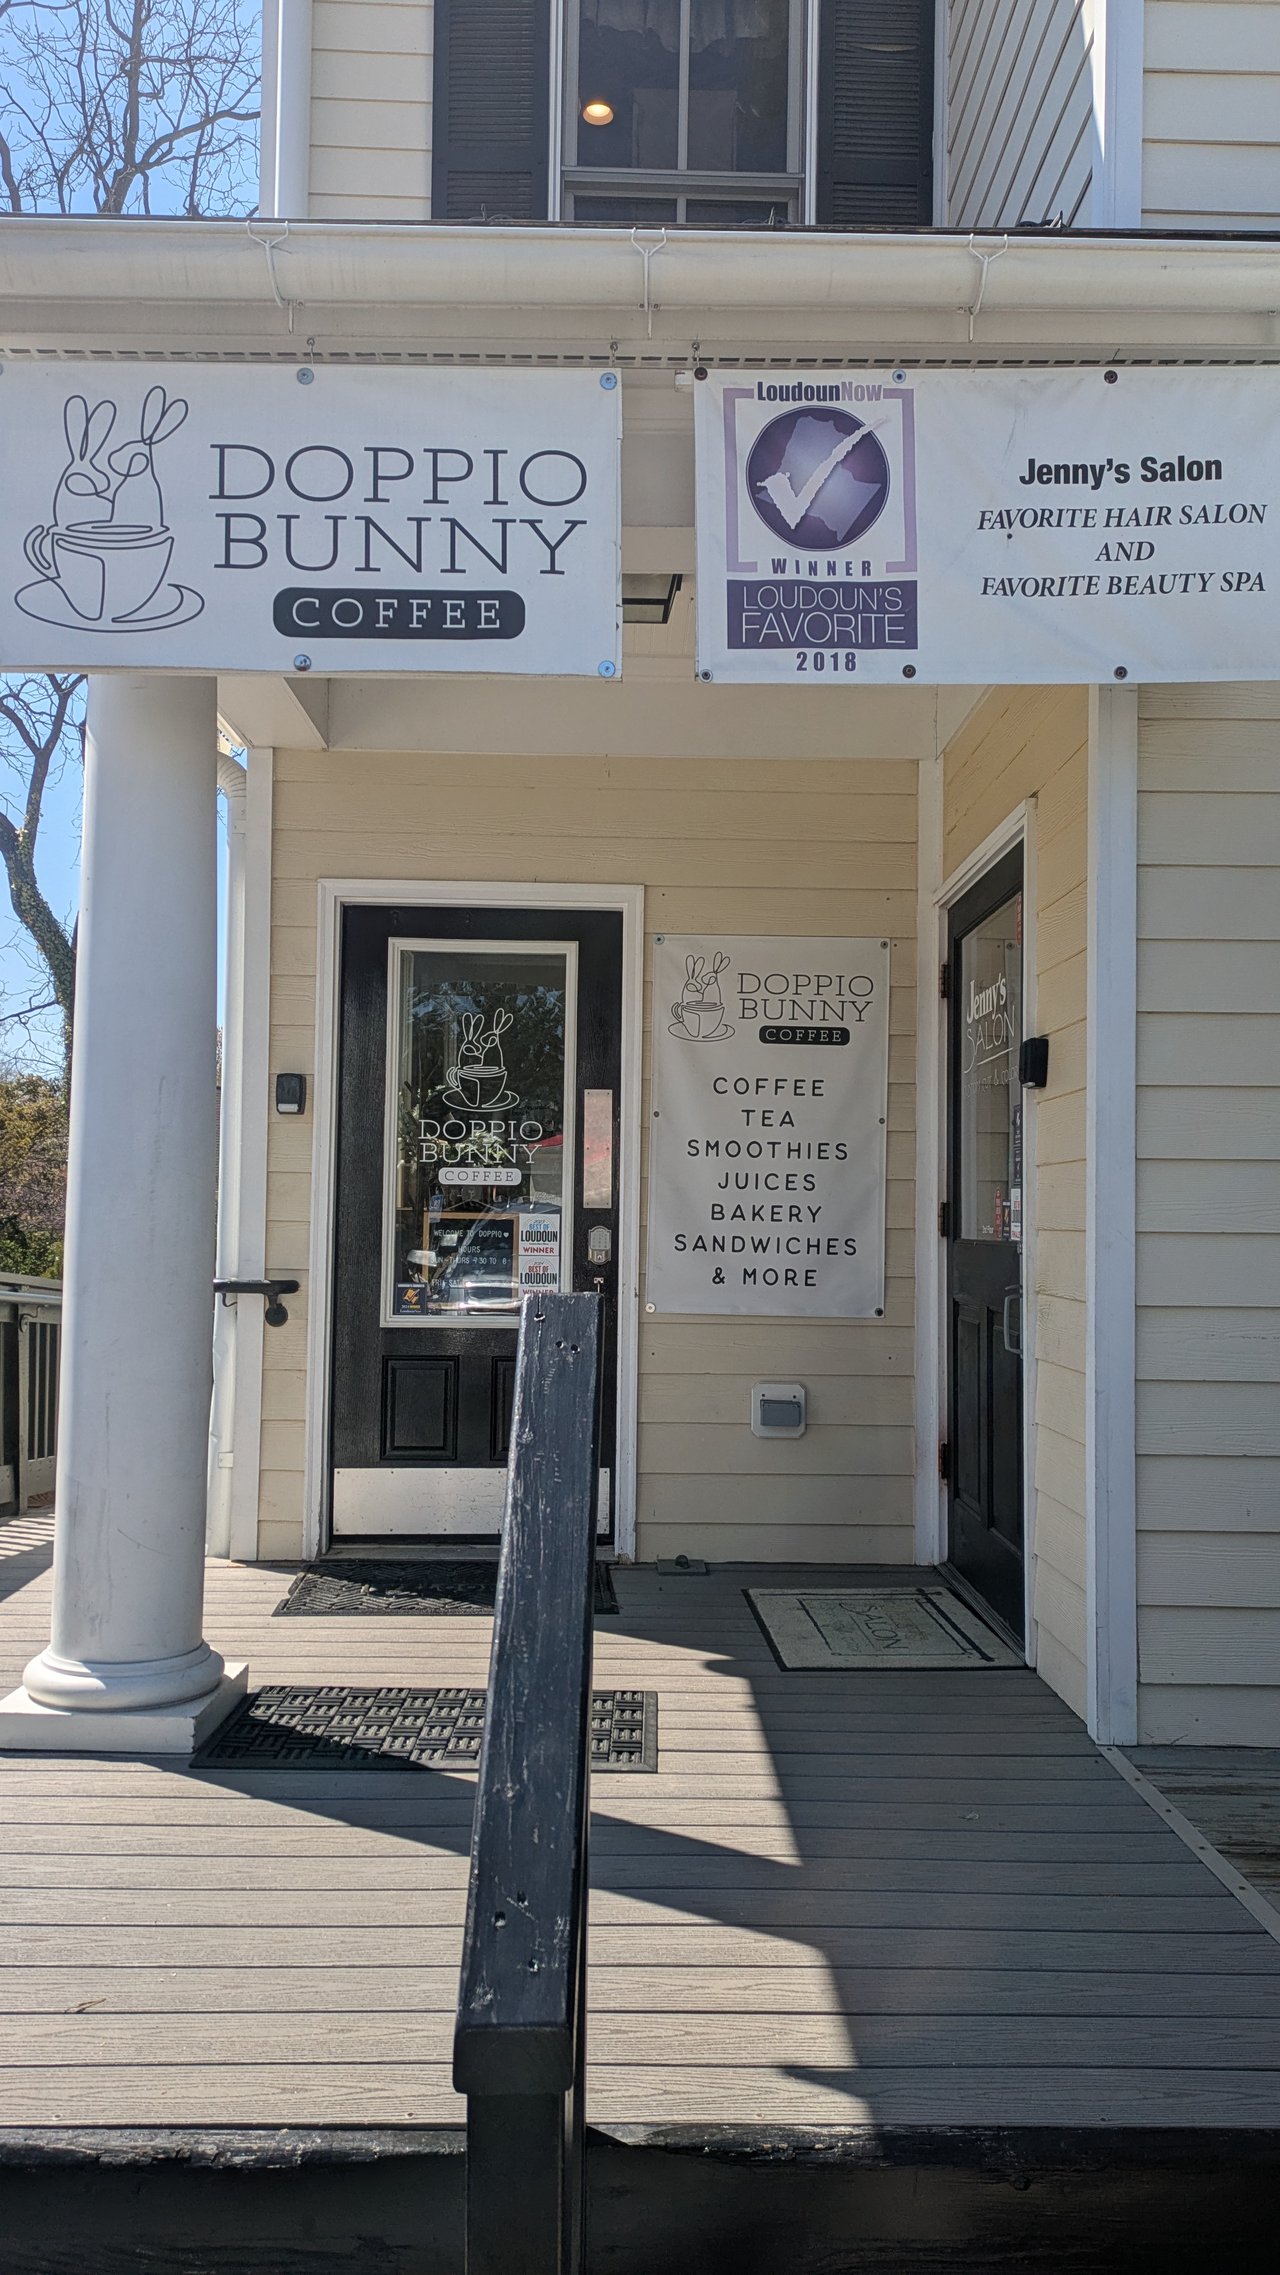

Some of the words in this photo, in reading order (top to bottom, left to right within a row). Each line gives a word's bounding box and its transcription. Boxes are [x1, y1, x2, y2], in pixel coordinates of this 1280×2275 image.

[757, 381, 882, 402] LoudounNow
[209, 444, 587, 506] DOPPIO
[1019, 458, 1131, 490] Jenny's
[1141, 455, 1222, 483] Salon
[977, 508, 1097, 531] FAVORITE
[1103, 506, 1172, 528] HAIR
[1179, 503, 1268, 526] SALON
[214, 513, 587, 575] BUNNY
[1095, 541, 1156, 562] AND
[771, 558, 872, 577] WINNER
[980, 576, 1100, 598] FAVORITE
[1107, 573, 1216, 597] BEAUTY
[1220, 571, 1266, 593] SPA
[742, 586, 903, 611] LOUDOUN'S
[292, 598, 500, 629] COFFEE
[741, 613, 906, 644] FAVORITE
[796, 652, 857, 672] 2018
[737, 972, 874, 997] DOPPIO
[966, 972, 1006, 1024] Jenny's
[738, 998, 873, 1023] BUNNY
[765, 1029, 842, 1042] COFFEE
[964, 1004, 1015, 1074] SALON
[713, 1077, 825, 1097] COFFEE
[741, 1109, 795, 1128] TEA
[418, 1119, 543, 1141] DOPPIO
[419, 1143, 542, 1165] BUNNY
[687, 1139, 848, 1161] SMOOTHIES
[444, 1171, 514, 1182] COFFEE
[718, 1172, 816, 1192] JUICES
[710, 1204, 822, 1223] BAKERY
[521, 1230, 558, 1242] LOUDOUN
[674, 1234, 857, 1257] SANDWICHES
[520, 1272, 557, 1284] LOUDOUN
[712, 1267, 726, 1285] &
[742, 1268, 817, 1287] MORE
[839, 1602, 908, 1651] SALON
